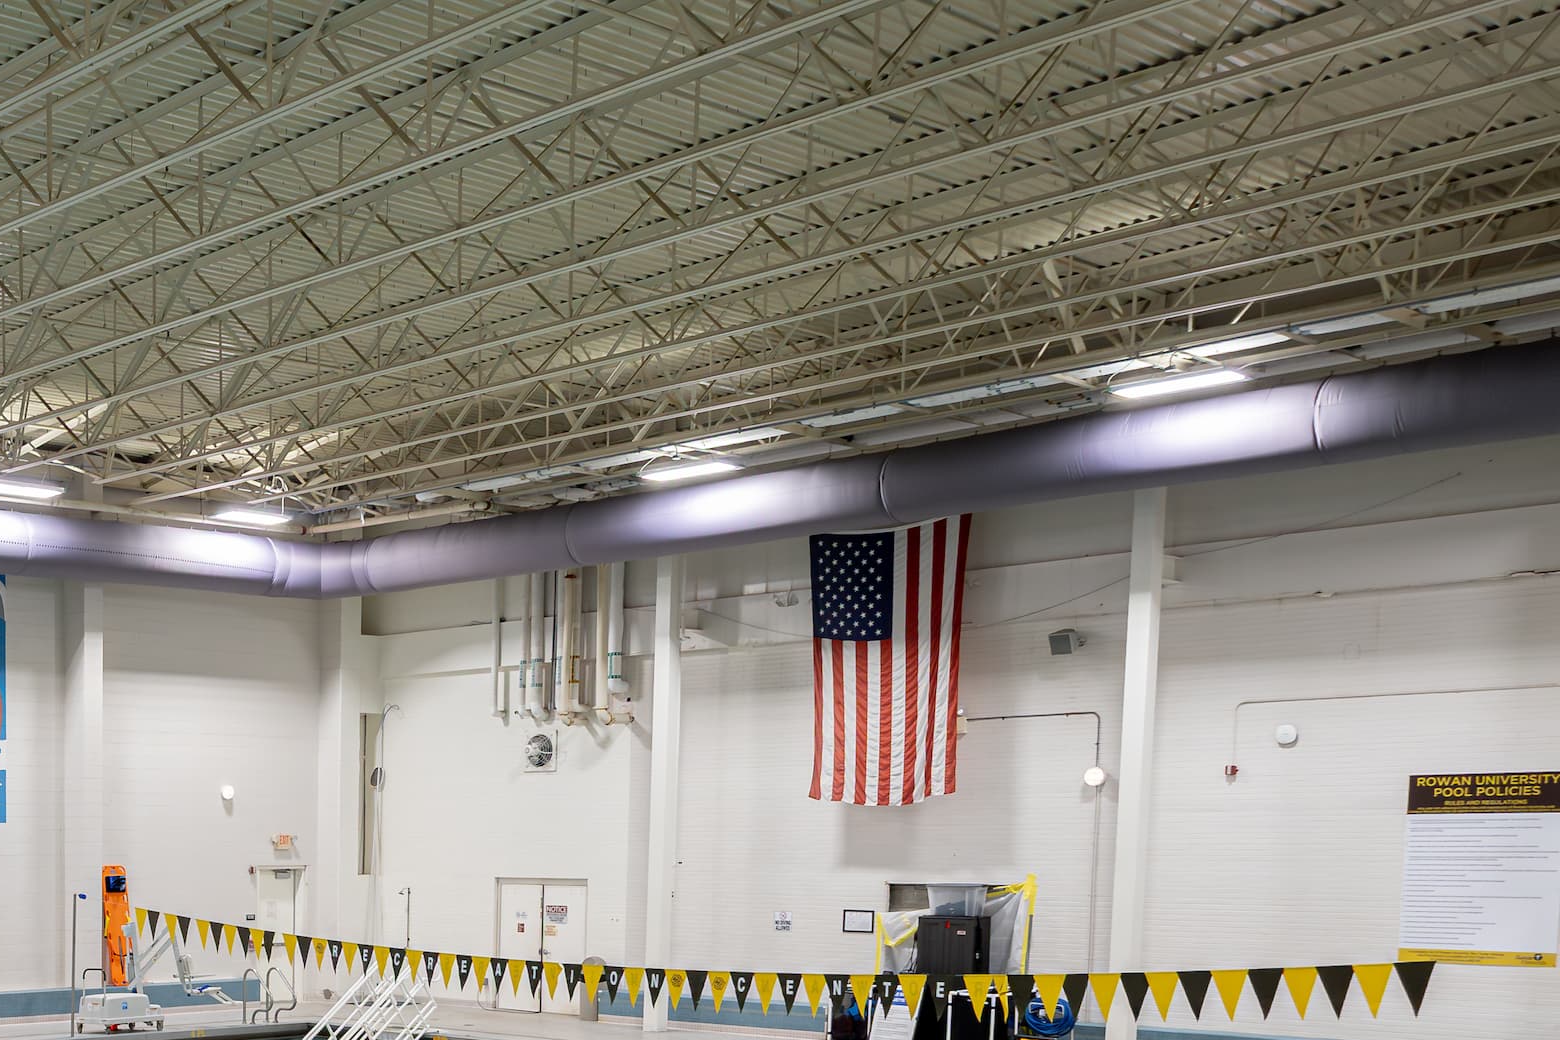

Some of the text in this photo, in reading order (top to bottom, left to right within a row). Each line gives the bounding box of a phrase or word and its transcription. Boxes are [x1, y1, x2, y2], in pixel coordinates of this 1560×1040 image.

[1416, 773, 1560, 787] ROWAN UNIVERSITY
[1433, 785, 1542, 798] POOL POLICIES
[546, 905, 567, 913] NOTICE
